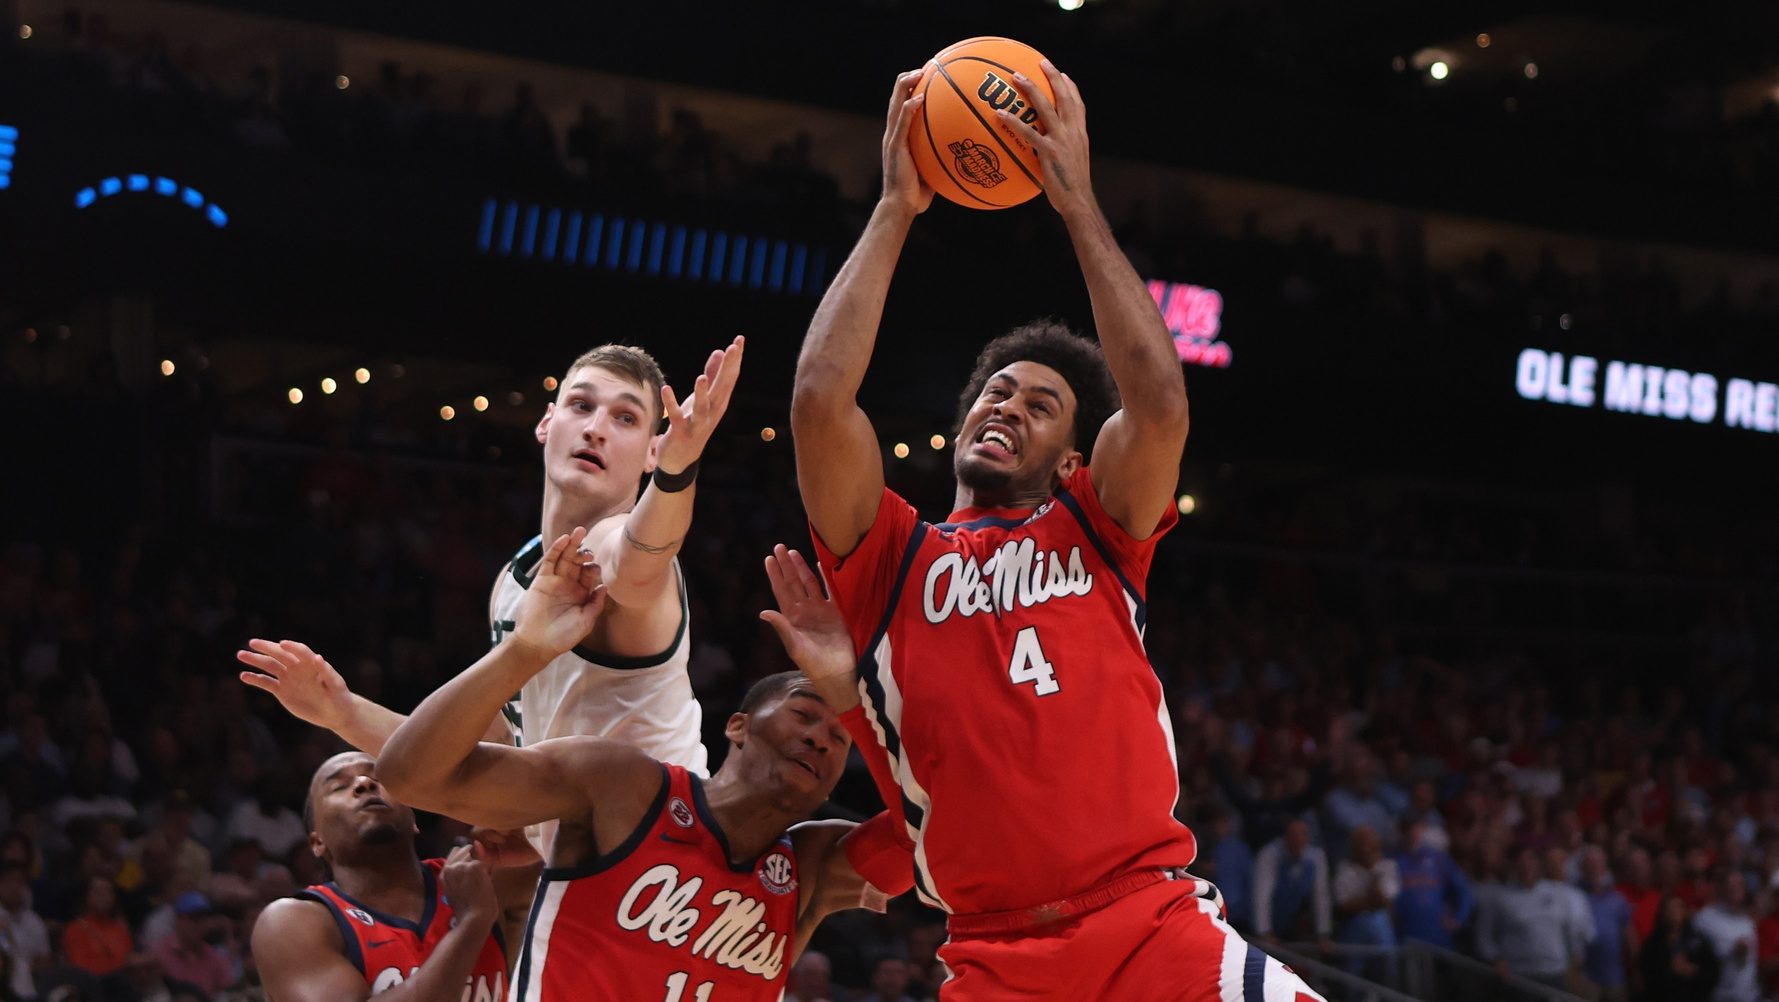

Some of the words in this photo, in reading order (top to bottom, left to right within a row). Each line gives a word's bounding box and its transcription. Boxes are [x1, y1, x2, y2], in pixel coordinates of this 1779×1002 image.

[962, 156, 996, 188] MADNESS
[967, 147, 994, 174] MARCH
[1516, 348, 1598, 407] OLE
[1603, 360, 1718, 423] MISS
[1725, 377, 1779, 434] RE
[923, 551, 994, 624] Ole
[982, 537, 1093, 619] Miss
[1008, 626, 1060, 697] 4
[765, 853, 792, 884] SEC
[616, 863, 703, 948] Ole
[691, 889, 788, 981] Miss
